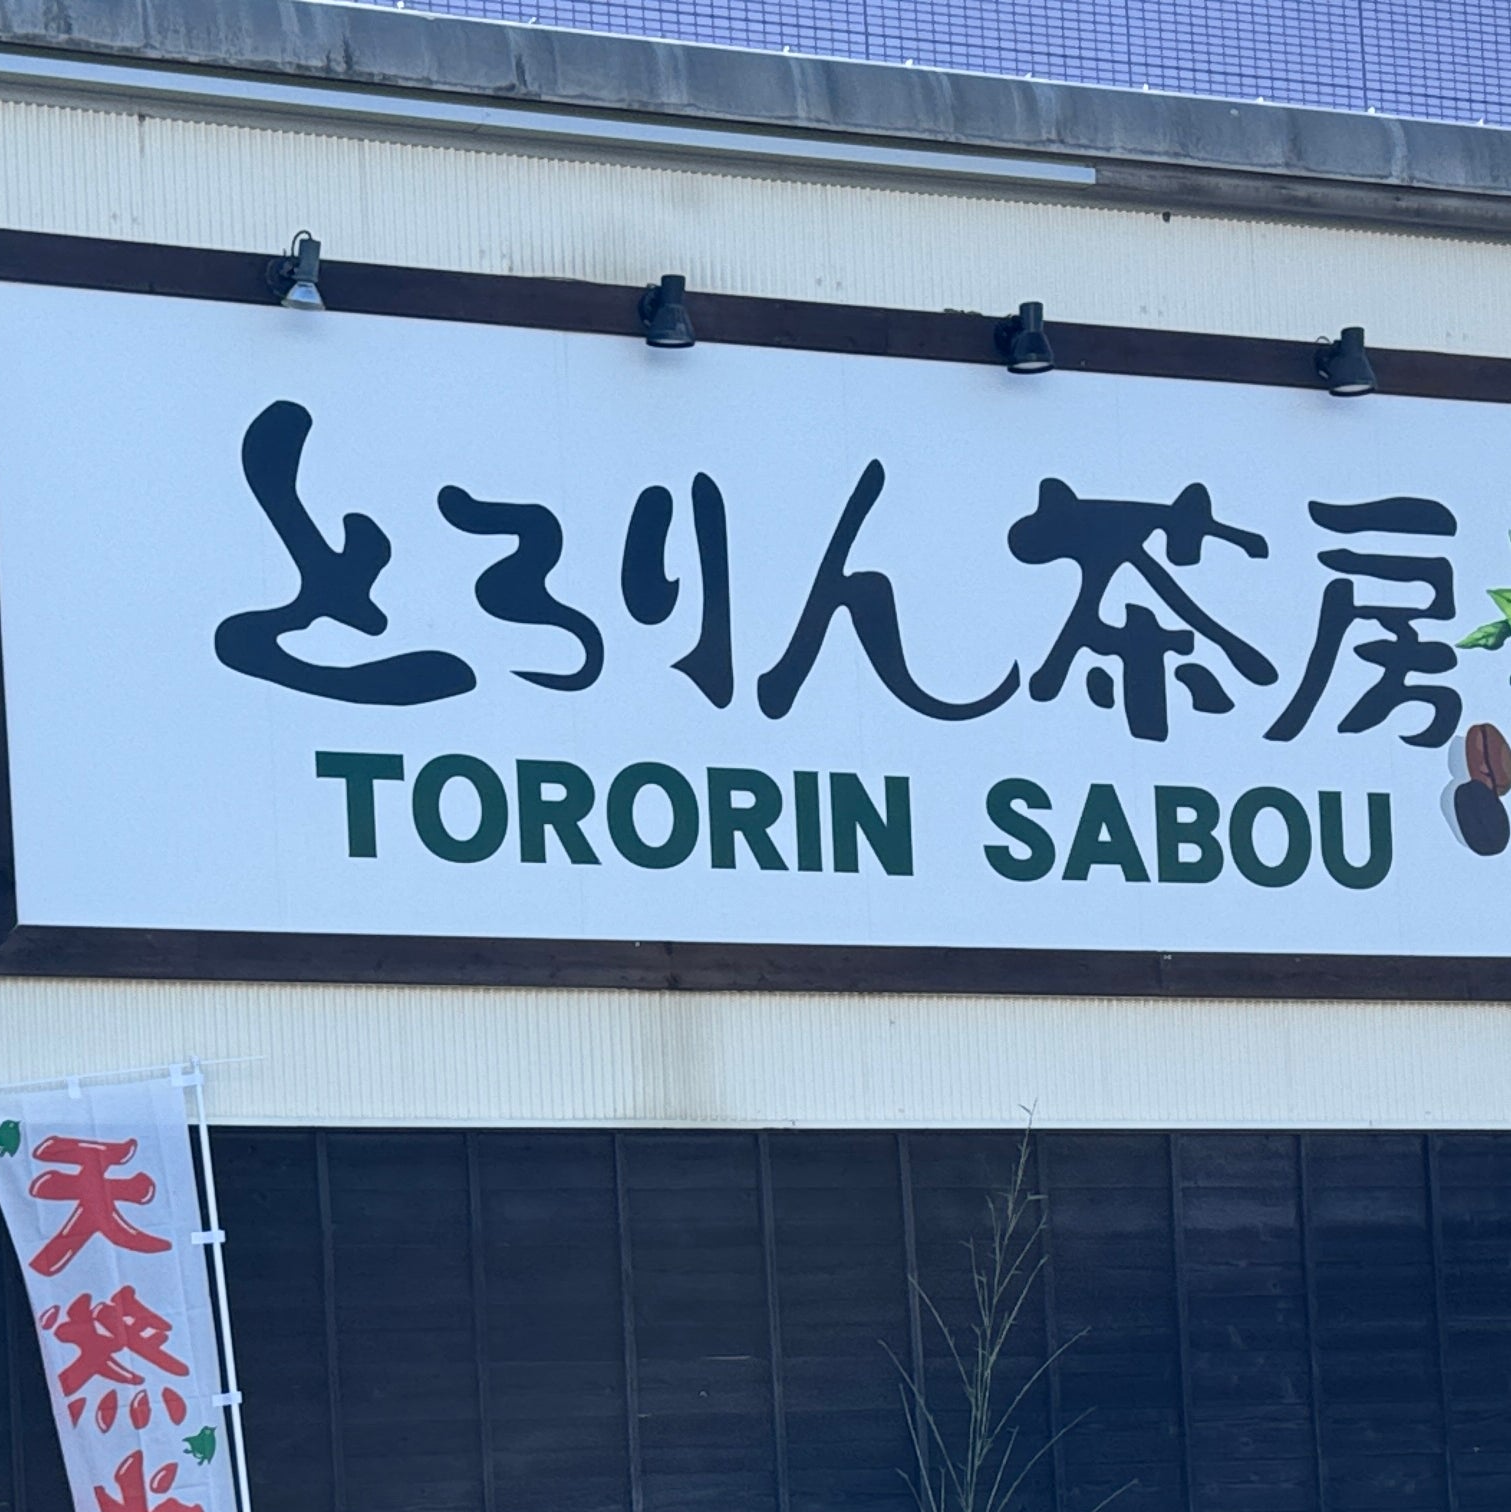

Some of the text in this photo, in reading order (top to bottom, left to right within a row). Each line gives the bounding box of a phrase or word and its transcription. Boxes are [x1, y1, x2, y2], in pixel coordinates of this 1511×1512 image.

[213, 400, 1464, 749] とろりん茶房
[314, 750, 1393, 890] TORORIN SABOU
